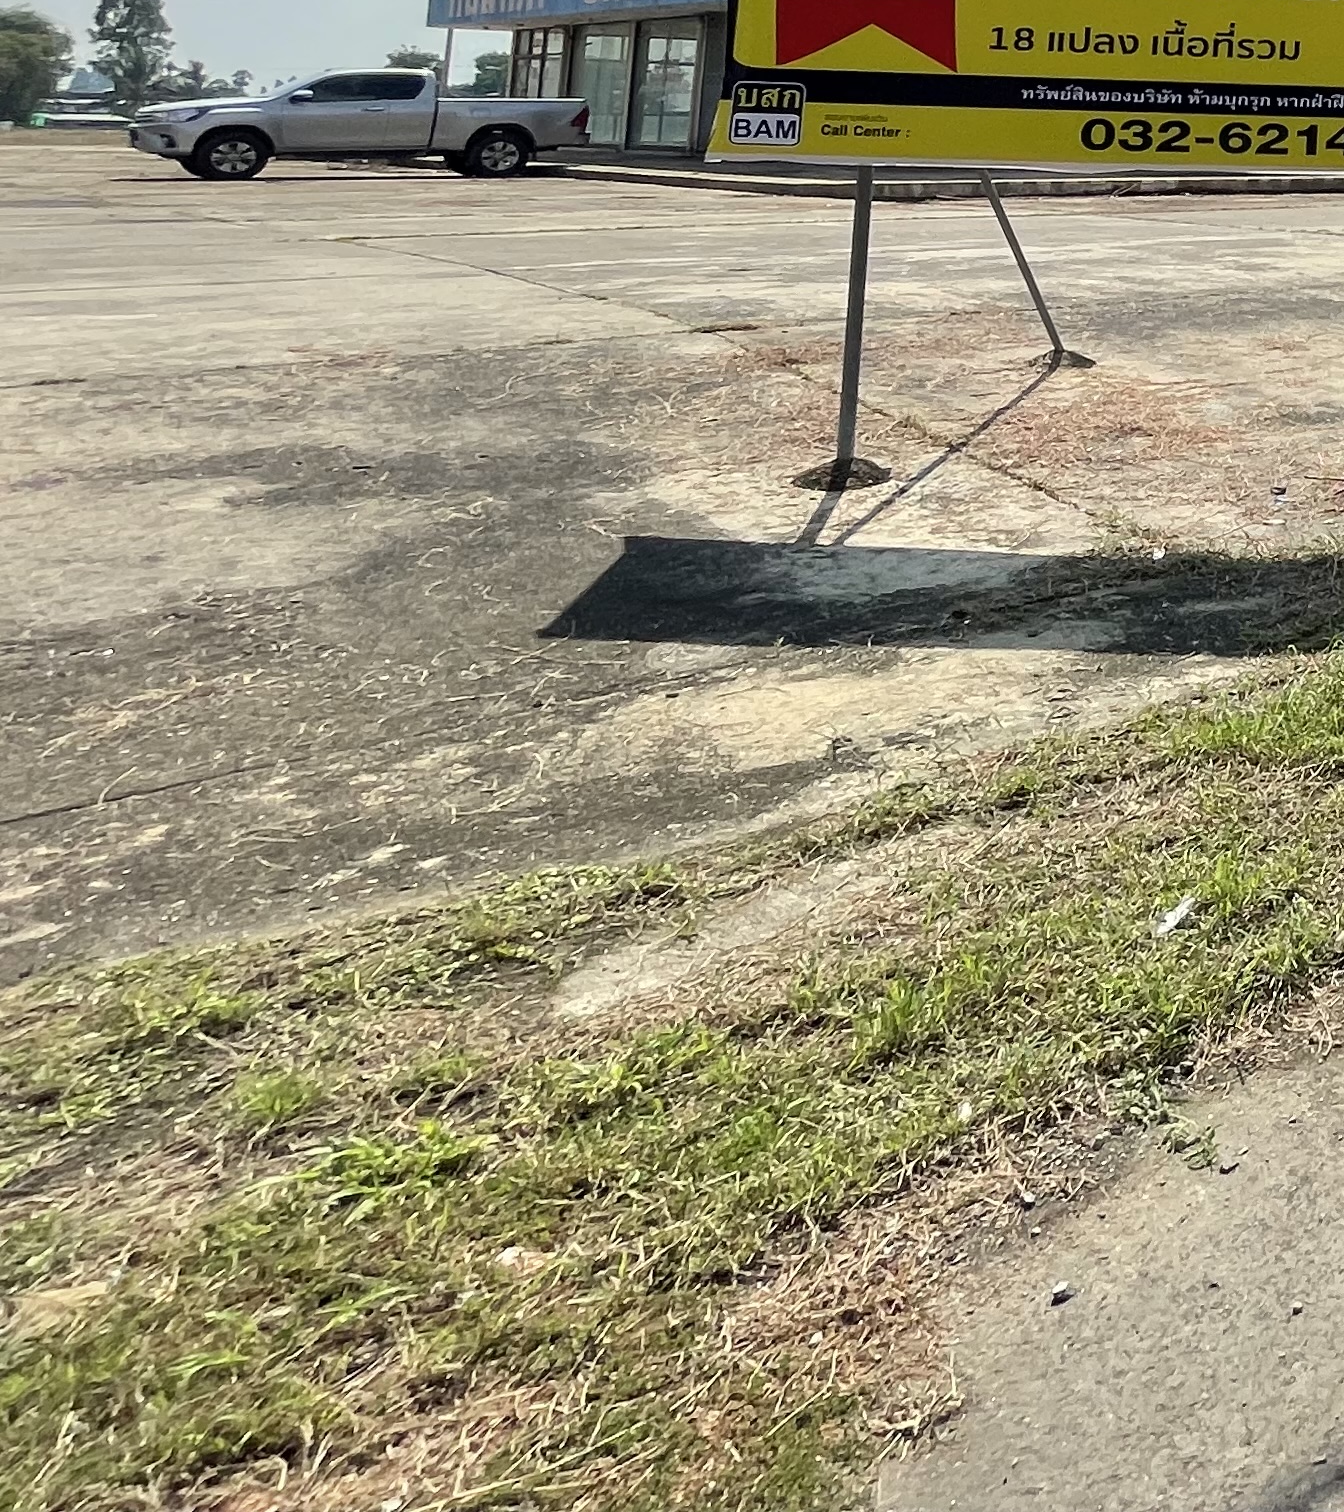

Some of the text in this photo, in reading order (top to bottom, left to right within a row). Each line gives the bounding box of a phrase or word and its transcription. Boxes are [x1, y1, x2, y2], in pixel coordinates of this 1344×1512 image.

[989, 26, 1035, 53] 18
[1047, 25, 1140, 56] แปลง
[1151, 20, 1301, 62] เนื้อที่รวม
[737, 87, 800, 109] บสก
[1021, 84, 1182, 104] ทรัพย์สินของบริษัท
[1188, 88, 1271, 111] ห้ามบุกรุก
[733, 118, 797, 140] BAM
[820, 124, 848, 136] Call
[853, 125, 901, 138] Center
